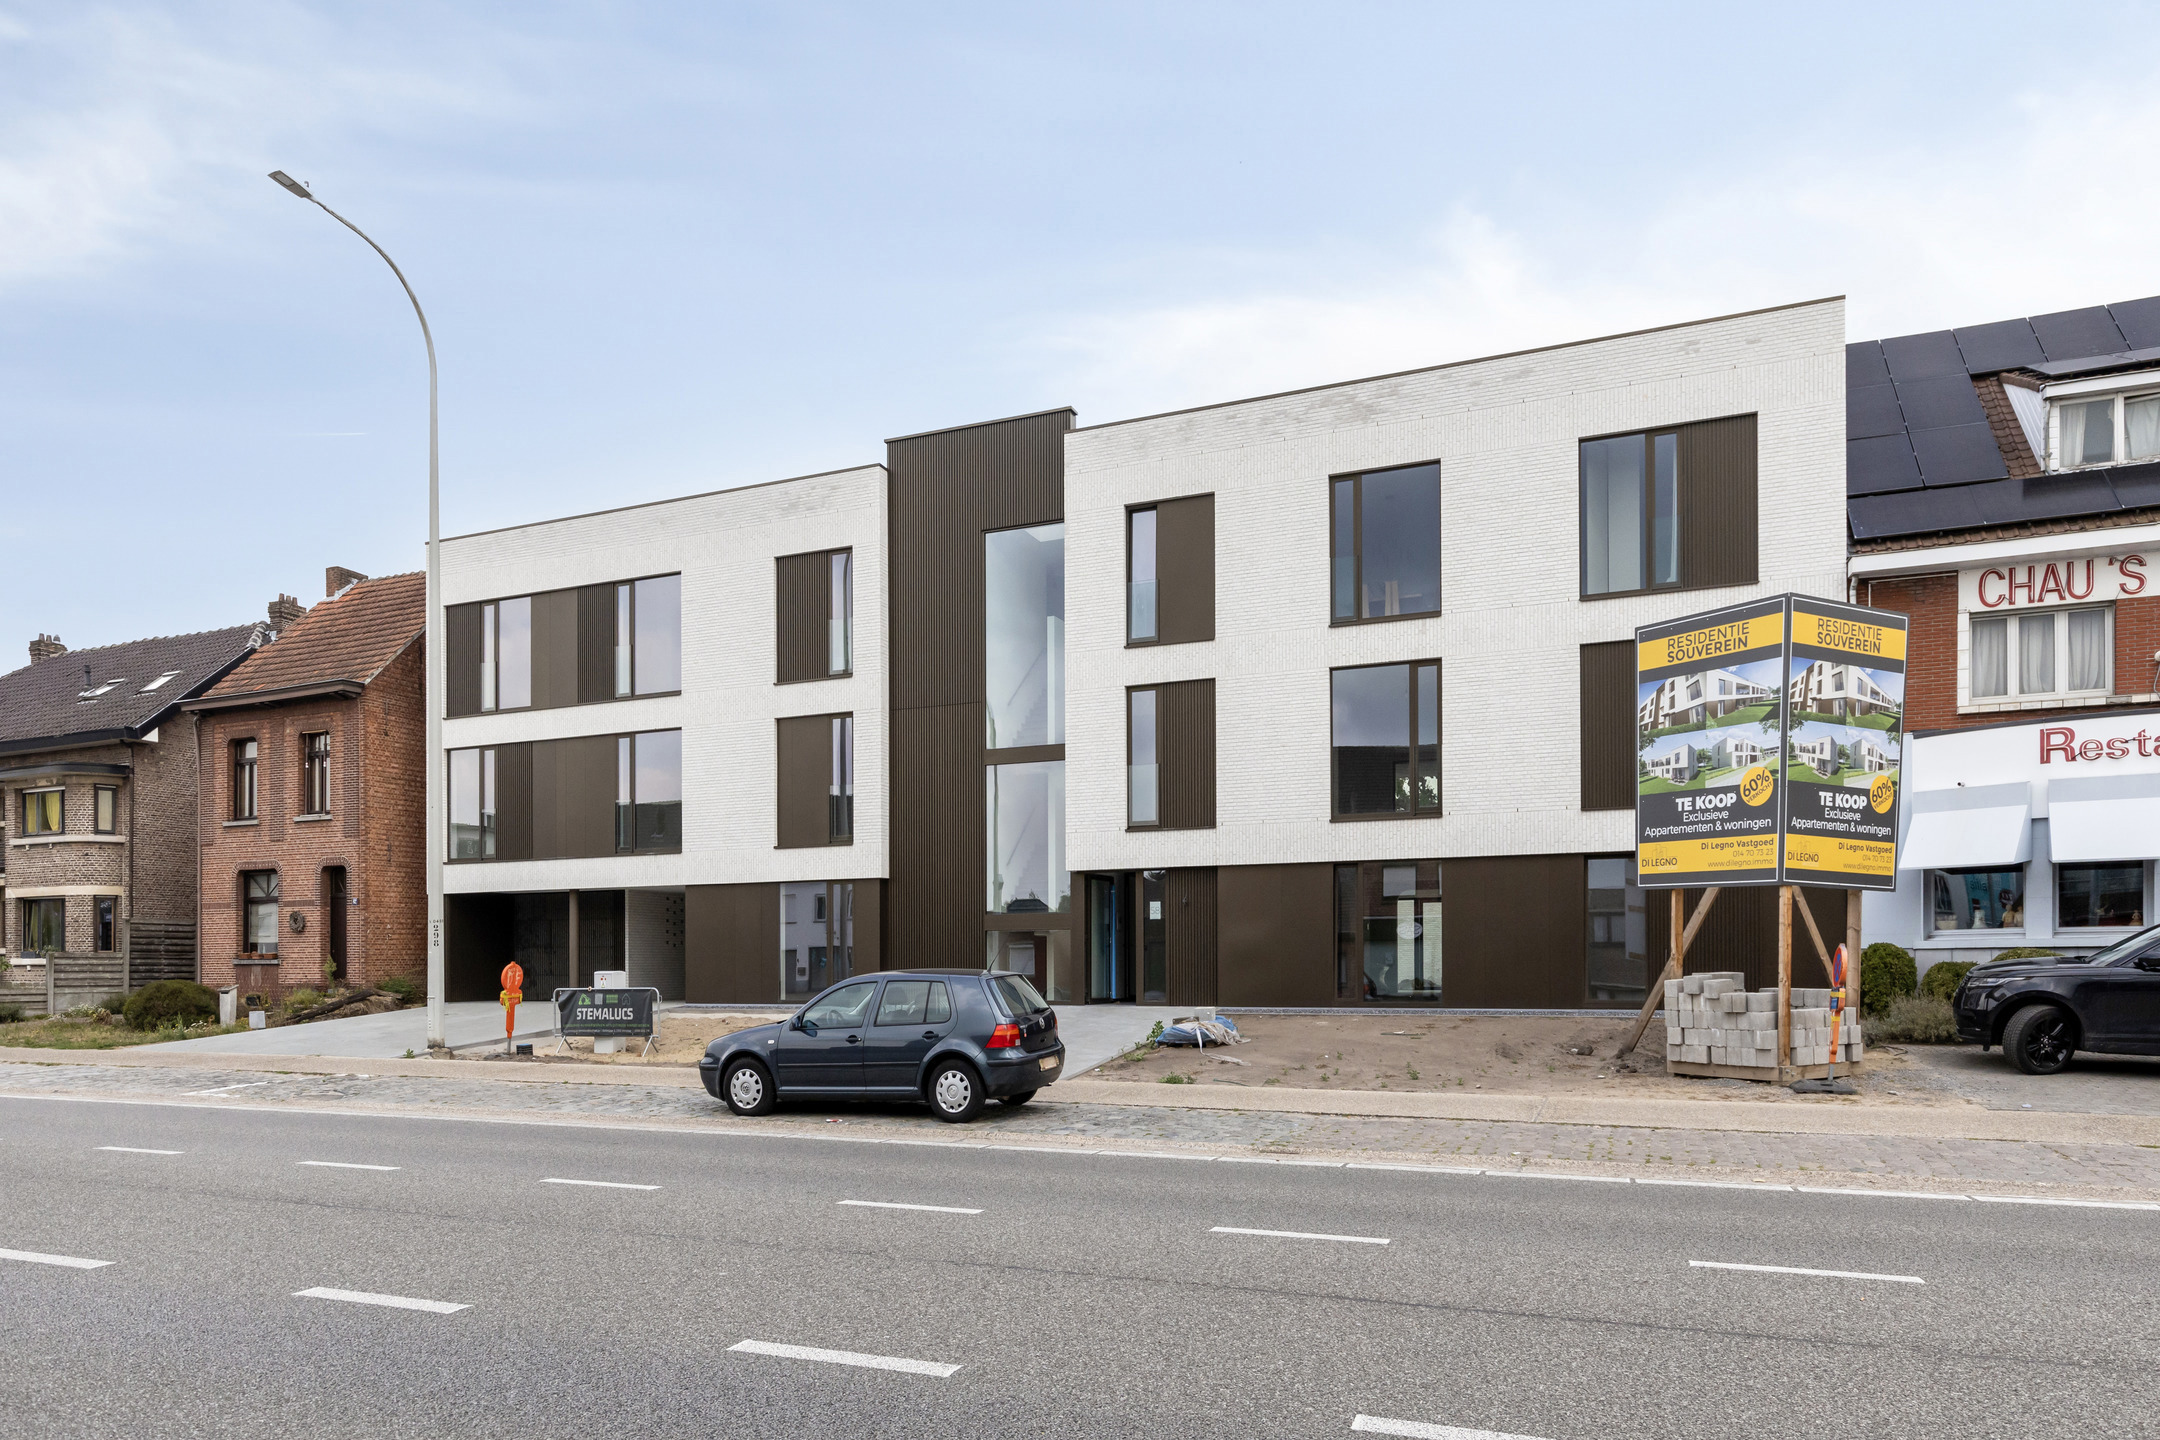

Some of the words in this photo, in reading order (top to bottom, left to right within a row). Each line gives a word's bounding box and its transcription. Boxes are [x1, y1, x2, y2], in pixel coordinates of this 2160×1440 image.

[1667, 621, 1750, 650] RESIDENTIE
[1818, 618, 1882, 640] RESIDENTIE
[1667, 636, 1748, 663] SOUVEREIN
[1817, 632, 1881, 654] SOUVEREIN
[2040, 726, 2160, 764] Rest
[1742, 769, 1770, 797] 60%
[1871, 779, 1892, 803] 60%
[1675, 797, 1693, 811] TE
[1695, 793, 1737, 810] KOOP
[1818, 791, 1833, 806] TE
[1835, 793, 1868, 810] KOOP
[1683, 809, 1729, 822] Exclusieve
[1824, 807, 1861, 821] Exclusieve
[1644, 821, 1713, 838] Appartementen
[1715, 821, 1722, 831] &
[1723, 818, 1772, 831] woningen
[1791, 816, 1849, 832] Appartementen
[1850, 822, 1856, 832] &
[1856, 823, 1892, 837] woningen
[1701, 842, 1709, 850] Di
[1710, 840, 1734, 851] Legno
[1736, 838, 1774, 849] Vastgoed
[1745, 849, 1754, 857] 70
[1846, 843, 1864, 852] Legno
[1865, 844, 1892, 855] Vastgoed
[1641, 859, 1650, 867] DI
[1651, 857, 1678, 867] LEGNO
[1707, 858, 1774, 868] www.dilegno.immo
[1787, 851, 1795, 860] DI
[1796, 852, 1819, 862] LEGNO
[576, 1007, 633, 1020] STEMALUCS
